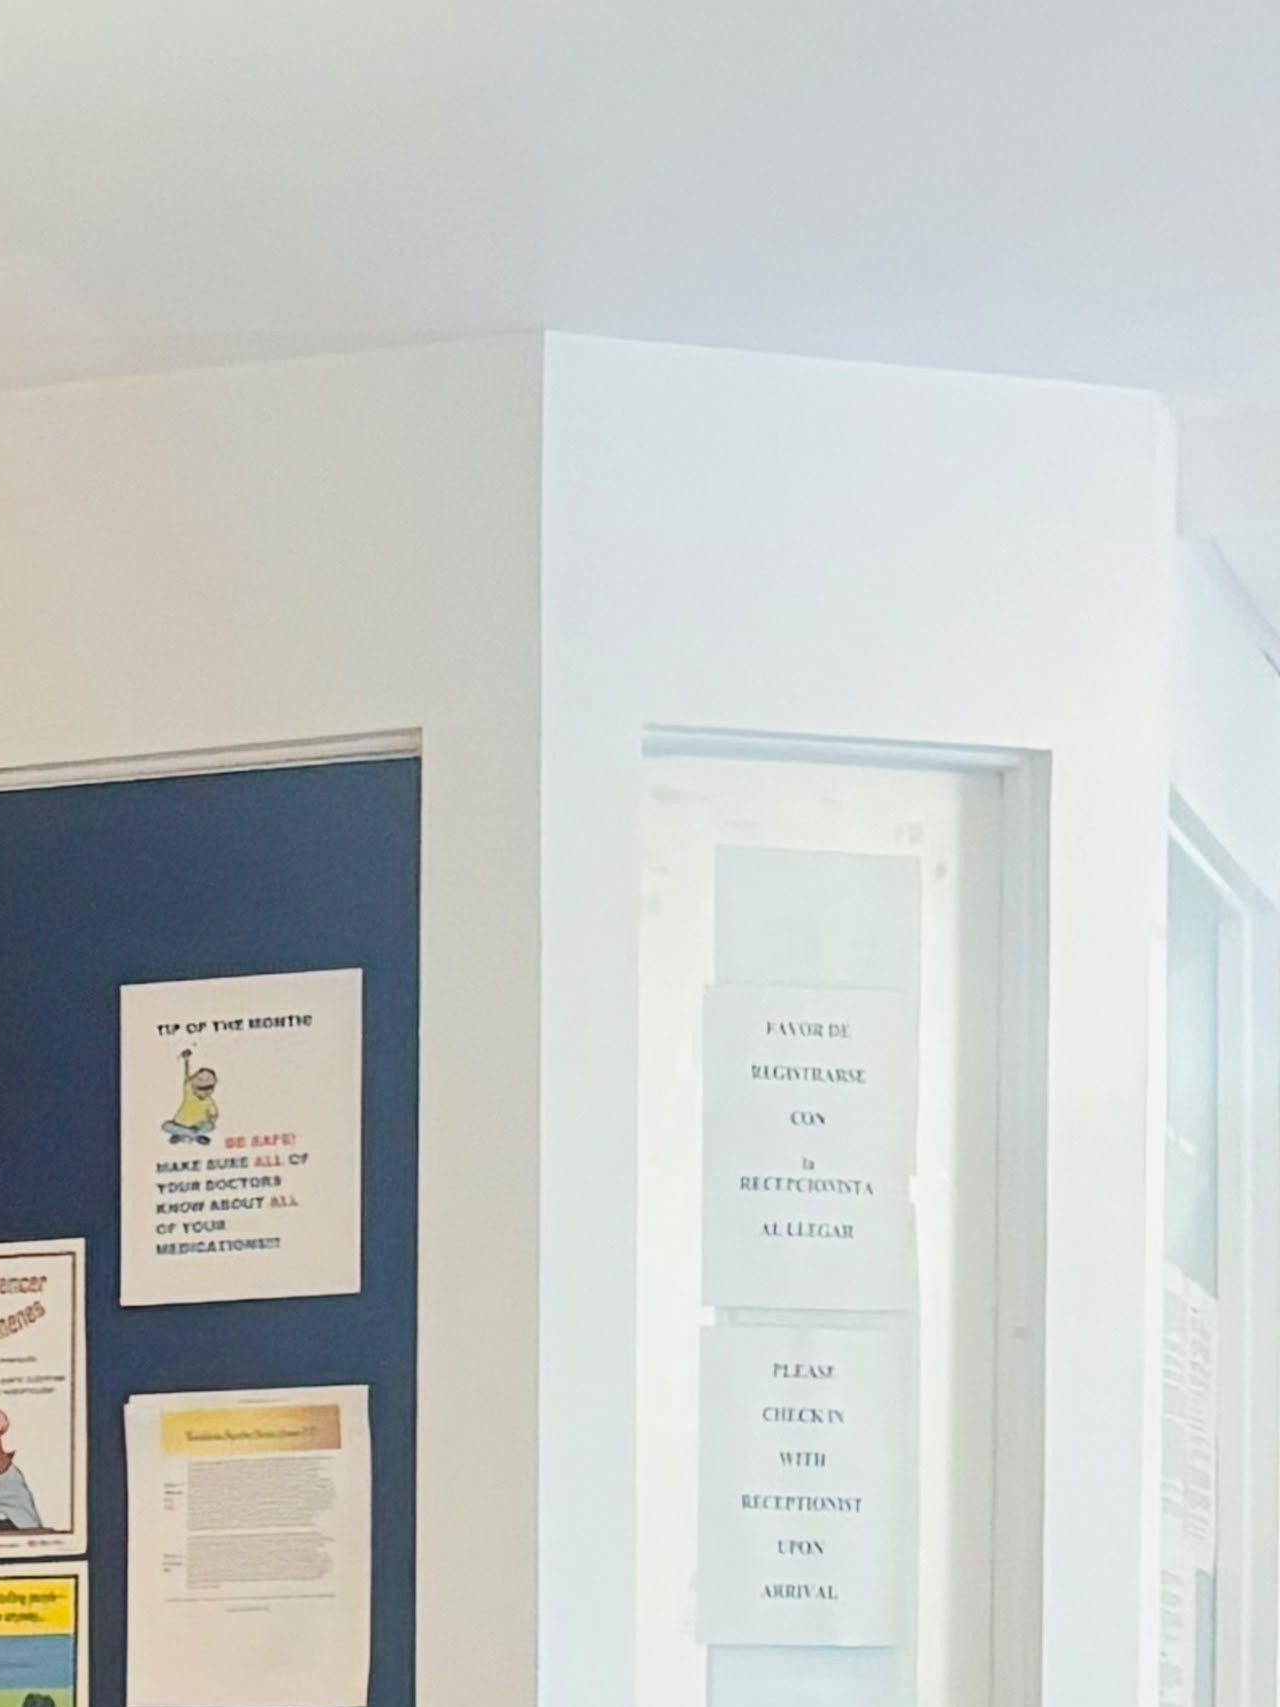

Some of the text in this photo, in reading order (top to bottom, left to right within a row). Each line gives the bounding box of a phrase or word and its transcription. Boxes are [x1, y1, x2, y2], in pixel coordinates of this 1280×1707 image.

[766, 1021, 851, 1039] FAVOR DE
[751, 1064, 866, 1084] REGISTRARSE
[790, 1110, 826, 1126] CON
[802, 1157, 815, 1170] la
[739, 1176, 874, 1196] RECEPCIONISTA
[760, 1222, 854, 1239] AL LLEGAR
[772, 1363, 835, 1379] PLEASE
[762, 1406, 845, 1424] CHECK IN
[779, 1451, 827, 1468] WITH
[741, 1494, 862, 1513] RECEPTIONIST
[777, 1539, 825, 1556] UPON
[761, 1584, 839, 1601] ARRIVAL
